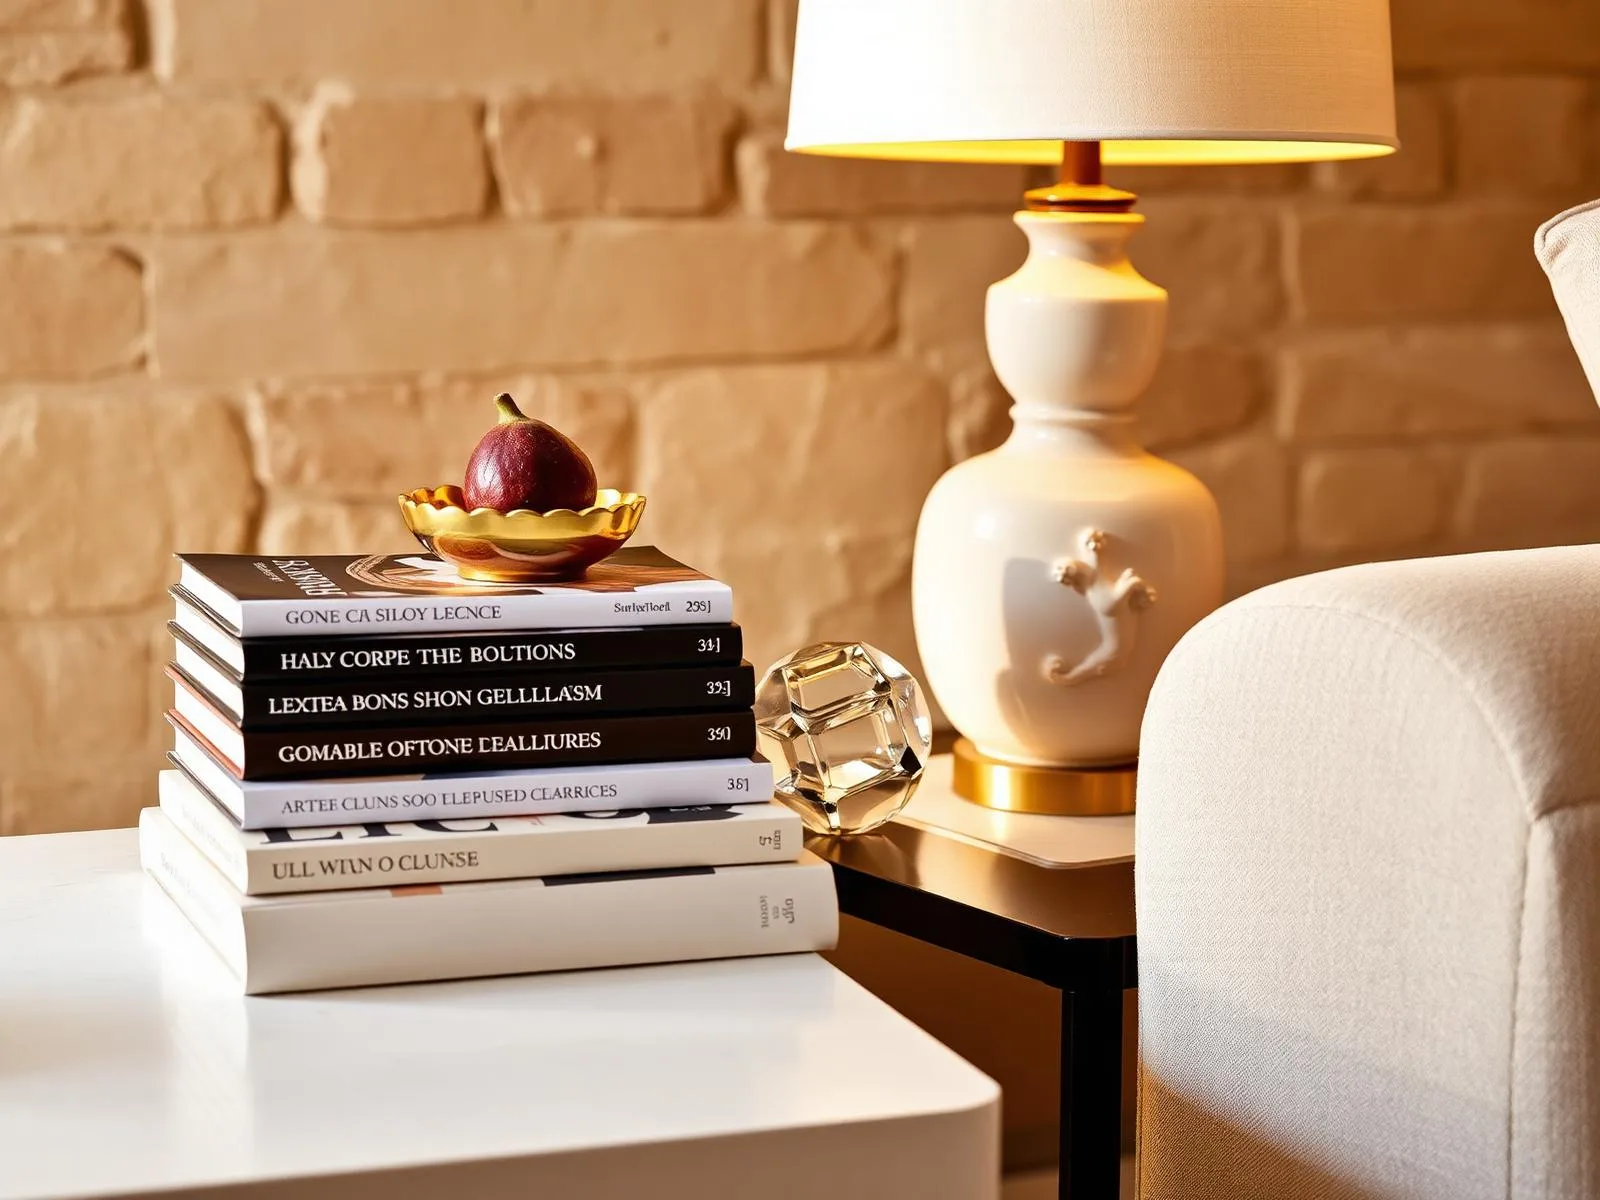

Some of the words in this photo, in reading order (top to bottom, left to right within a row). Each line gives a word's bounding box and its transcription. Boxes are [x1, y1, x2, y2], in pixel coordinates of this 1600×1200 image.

[286, 609, 341, 624] GONE
[376, 607, 428, 622] SILOY
[281, 651, 335, 670] HALY
[340, 649, 410, 668] CORPE
[417, 647, 462, 665] THE
[470, 643, 576, 663] BOLTIONS
[269, 695, 348, 714] LEXTEA
[352, 692, 409, 711] BONS
[413, 689, 472, 709] SHON
[278, 742, 383, 763] GOMABLE
[387, 737, 473, 758] OFTONE
[342, 795, 398, 811] CLUNS
[402, 793, 437, 808] SOO
[272, 861, 315, 880] ULL
[378, 856, 393, 873] O
